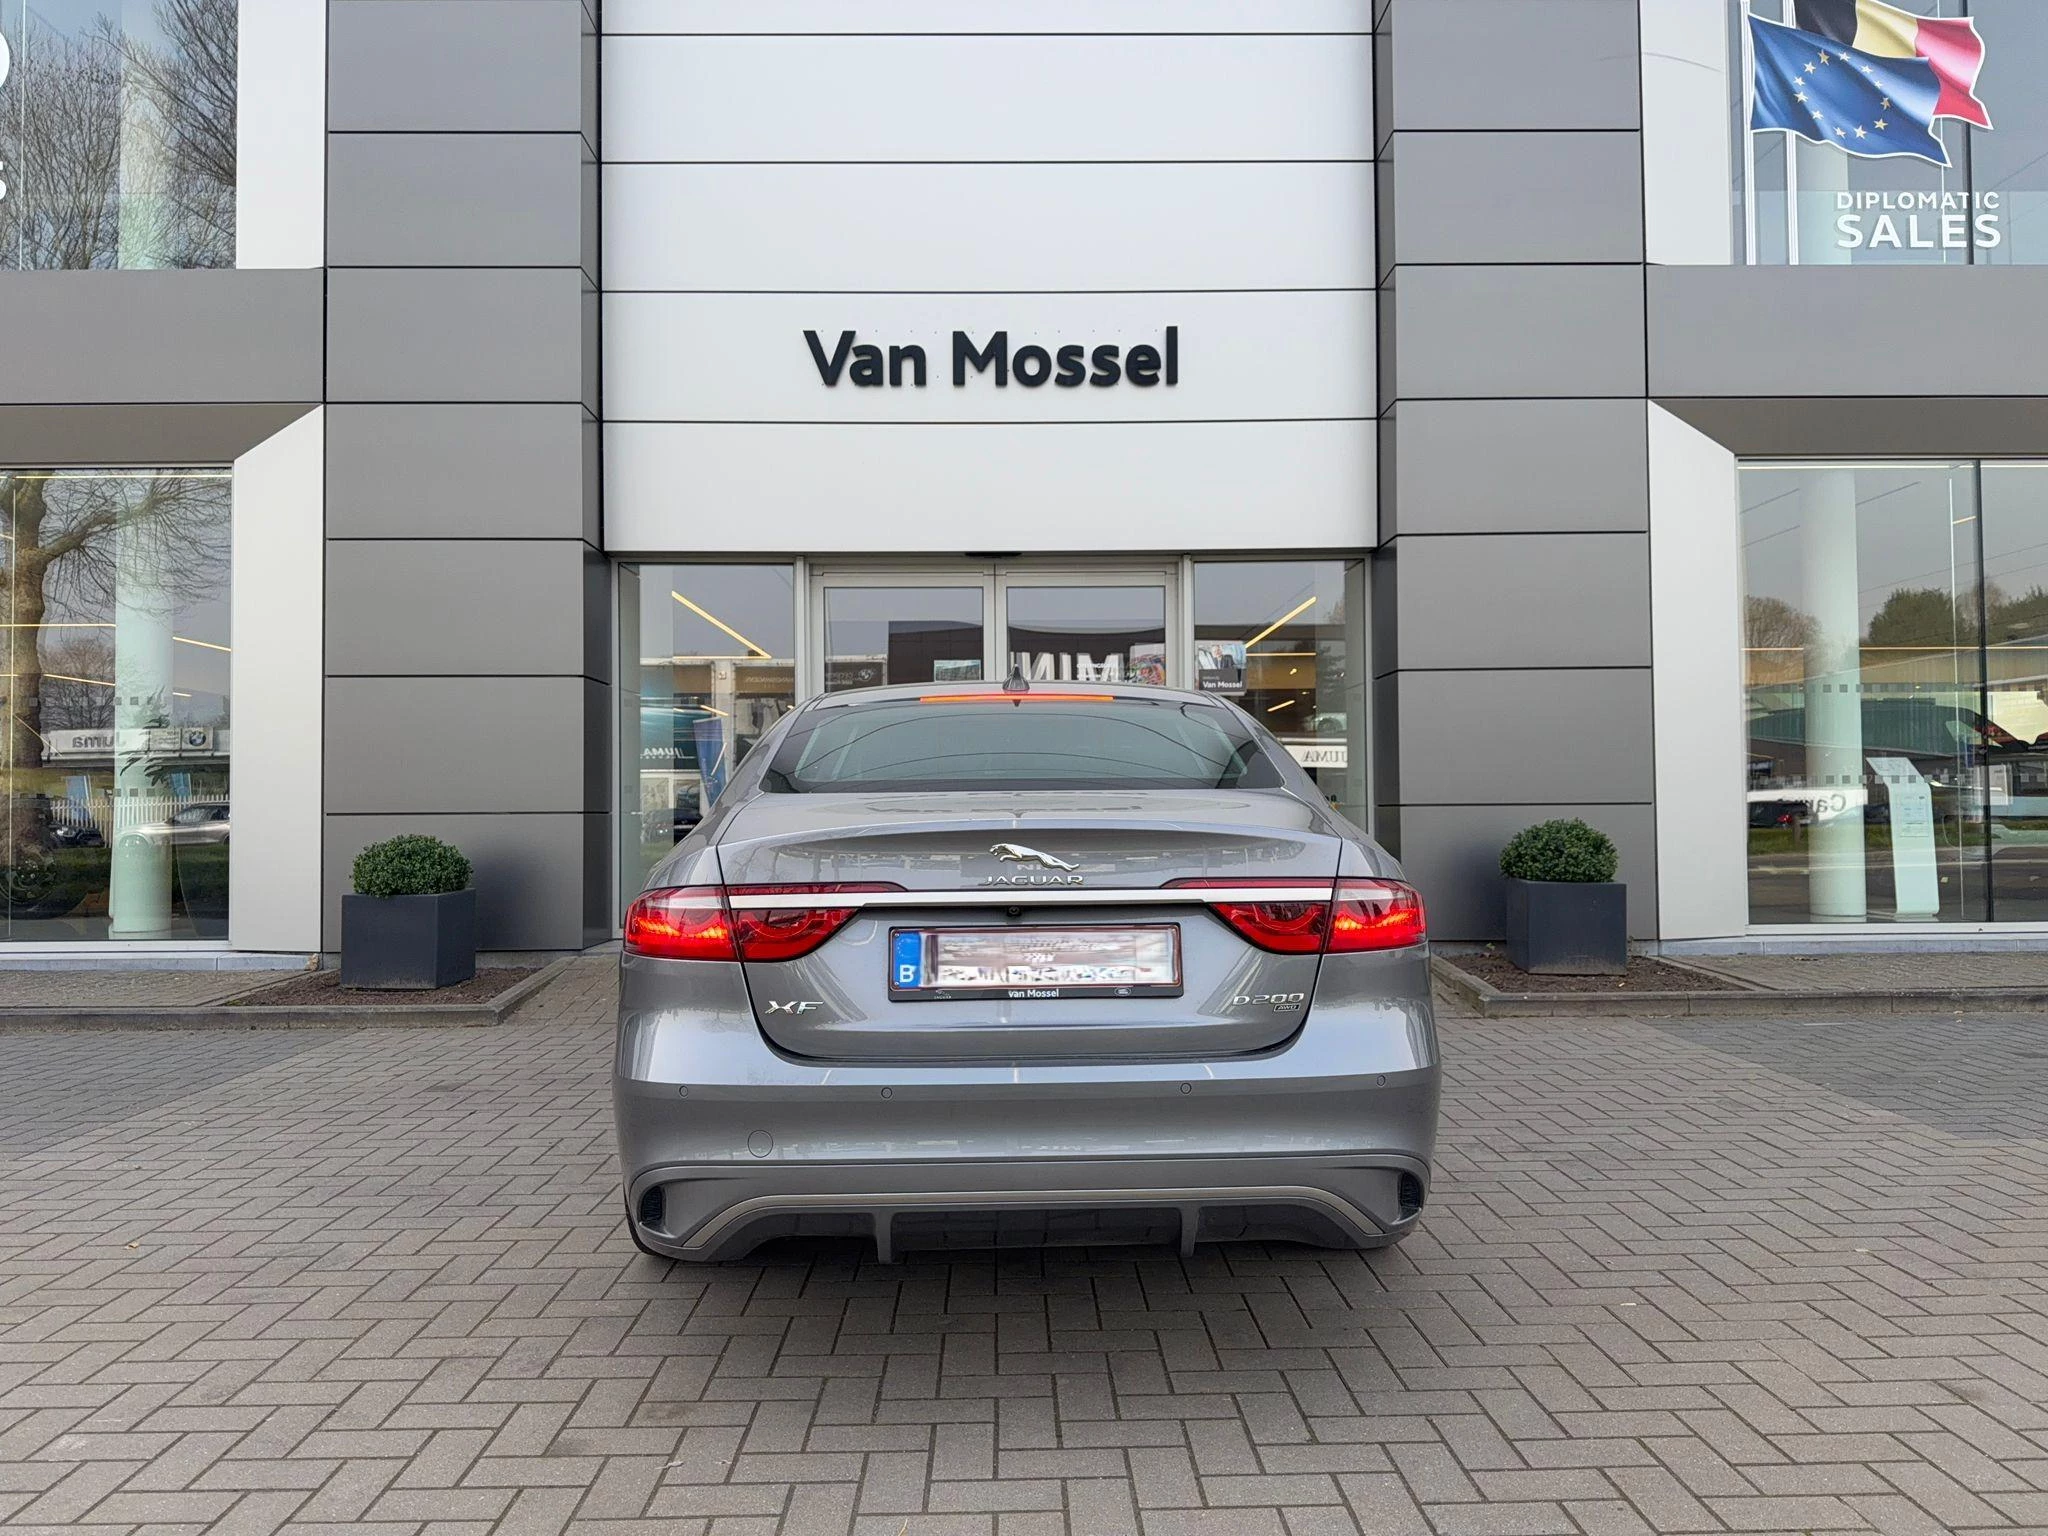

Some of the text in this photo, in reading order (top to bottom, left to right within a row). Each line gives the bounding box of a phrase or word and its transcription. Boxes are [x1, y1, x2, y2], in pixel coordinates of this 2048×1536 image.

[1837, 191, 2000, 210] DIPLOMATIC
[1836, 214, 2001, 248] SALES
[803, 326, 1179, 387] Van Mossel
[979, 875, 1084, 886] JAGUAR
[899, 965, 914, 983] B
[1026, 988, 1060, 998] Mossel
[1232, 992, 1305, 1005] D200
[764, 1000, 824, 1015] XF
